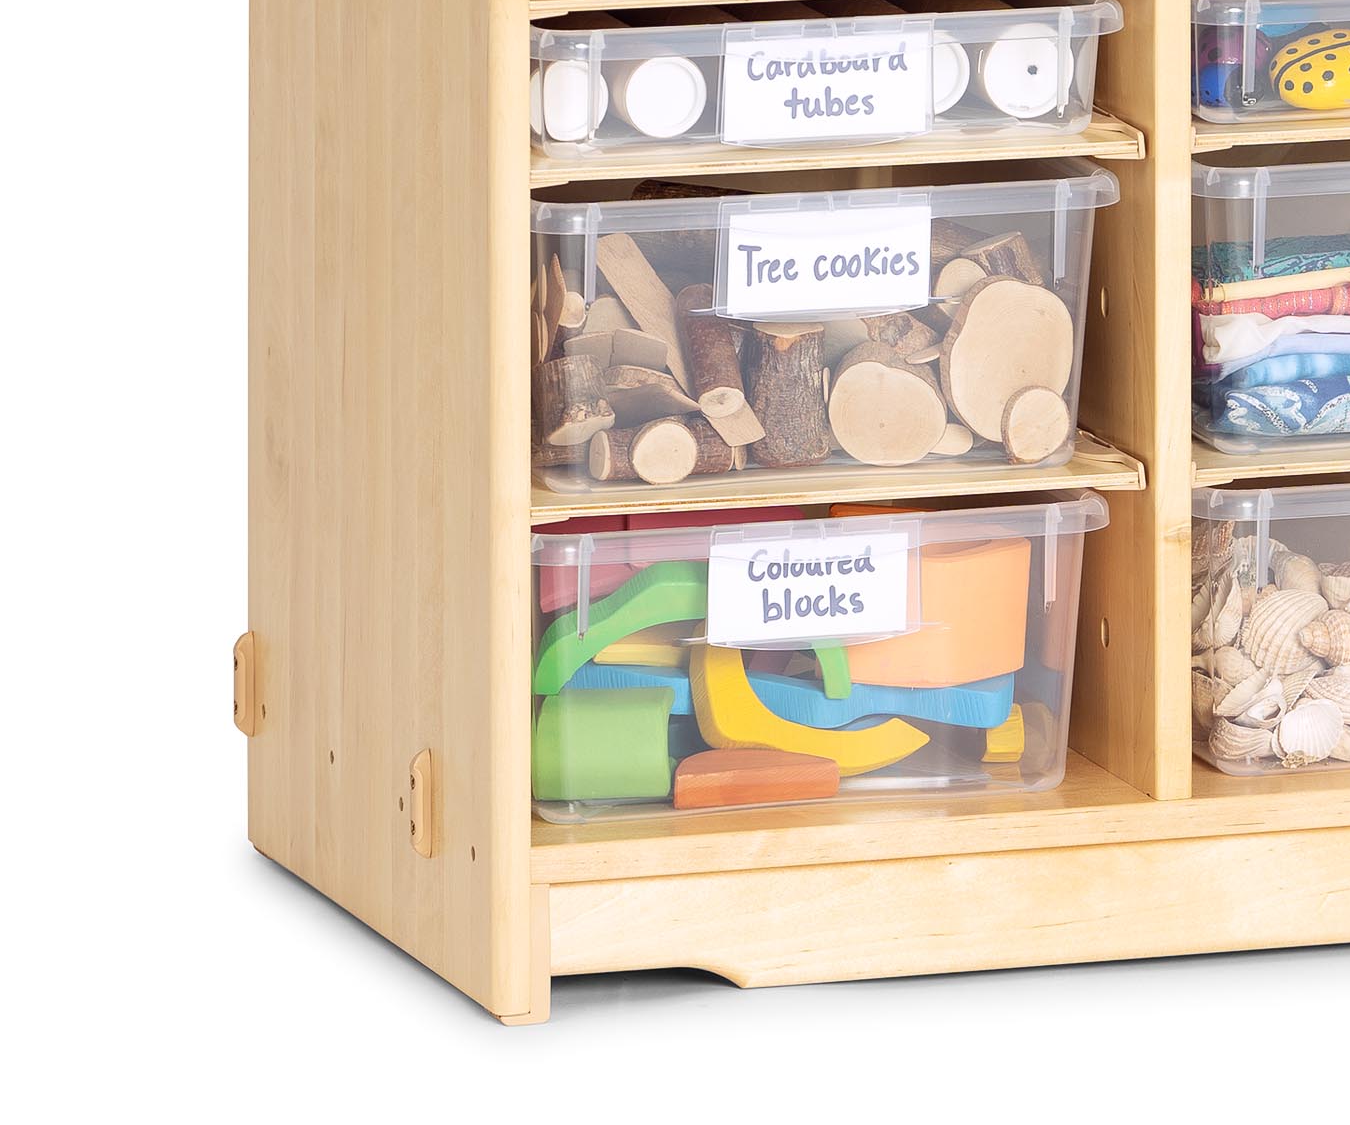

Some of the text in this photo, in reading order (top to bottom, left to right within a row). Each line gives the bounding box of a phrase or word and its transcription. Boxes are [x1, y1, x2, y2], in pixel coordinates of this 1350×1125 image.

[747, 41, 908, 81] Cardboard
[784, 86, 875, 120] tubes
[738, 245, 920, 287] Tree cookies
[748, 545, 875, 582] Coloured
[762, 585, 864, 623] blocks
